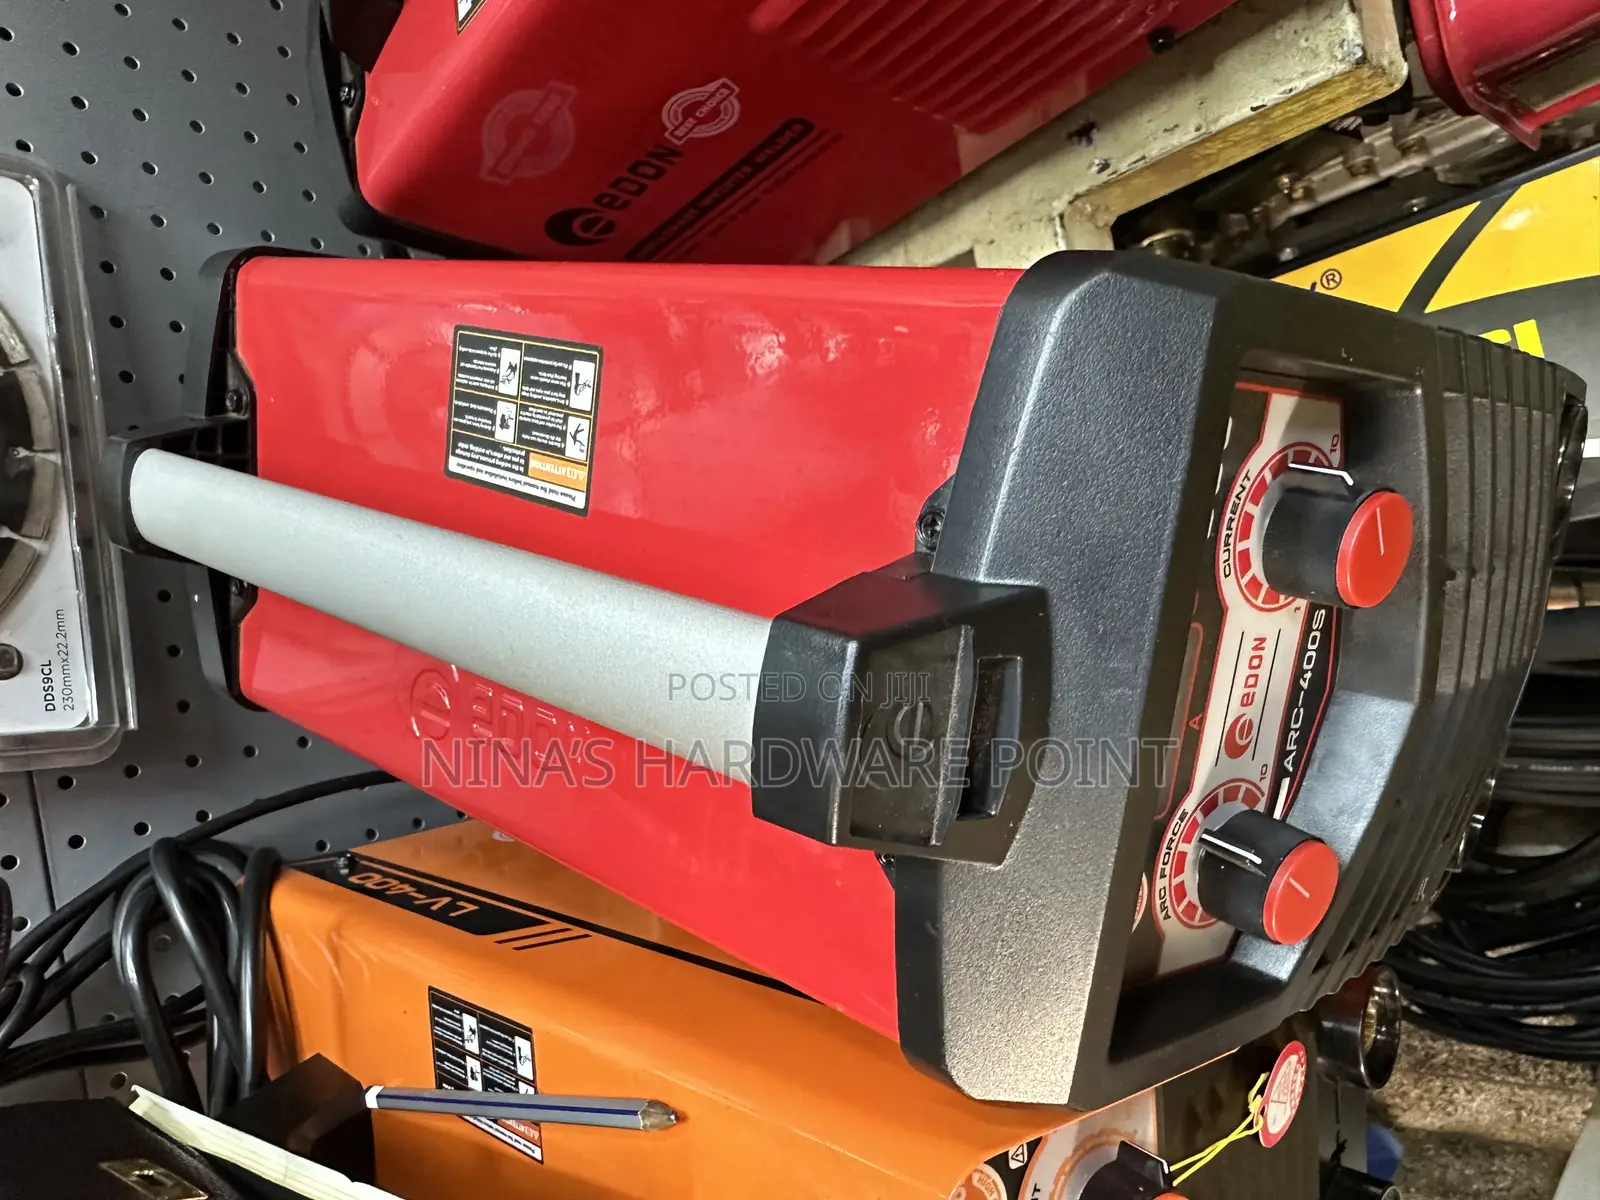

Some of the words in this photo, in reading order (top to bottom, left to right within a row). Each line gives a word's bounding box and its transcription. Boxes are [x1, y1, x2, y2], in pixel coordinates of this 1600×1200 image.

[1330, 434, 1340, 454] 10
[1222, 468, 1251, 578] CURRENT
[40, 659, 56, 712] DDS9CL
[56, 608, 75, 712] 230mmx22.2mm
[1283, 608, 1326, 773] ARC-400S
[1259, 763, 1269, 783] 10
[1158, 808, 1189, 880] FORCE
[347, 872, 480, 917] LV-400
[1158, 886, 1172, 921] ARC
